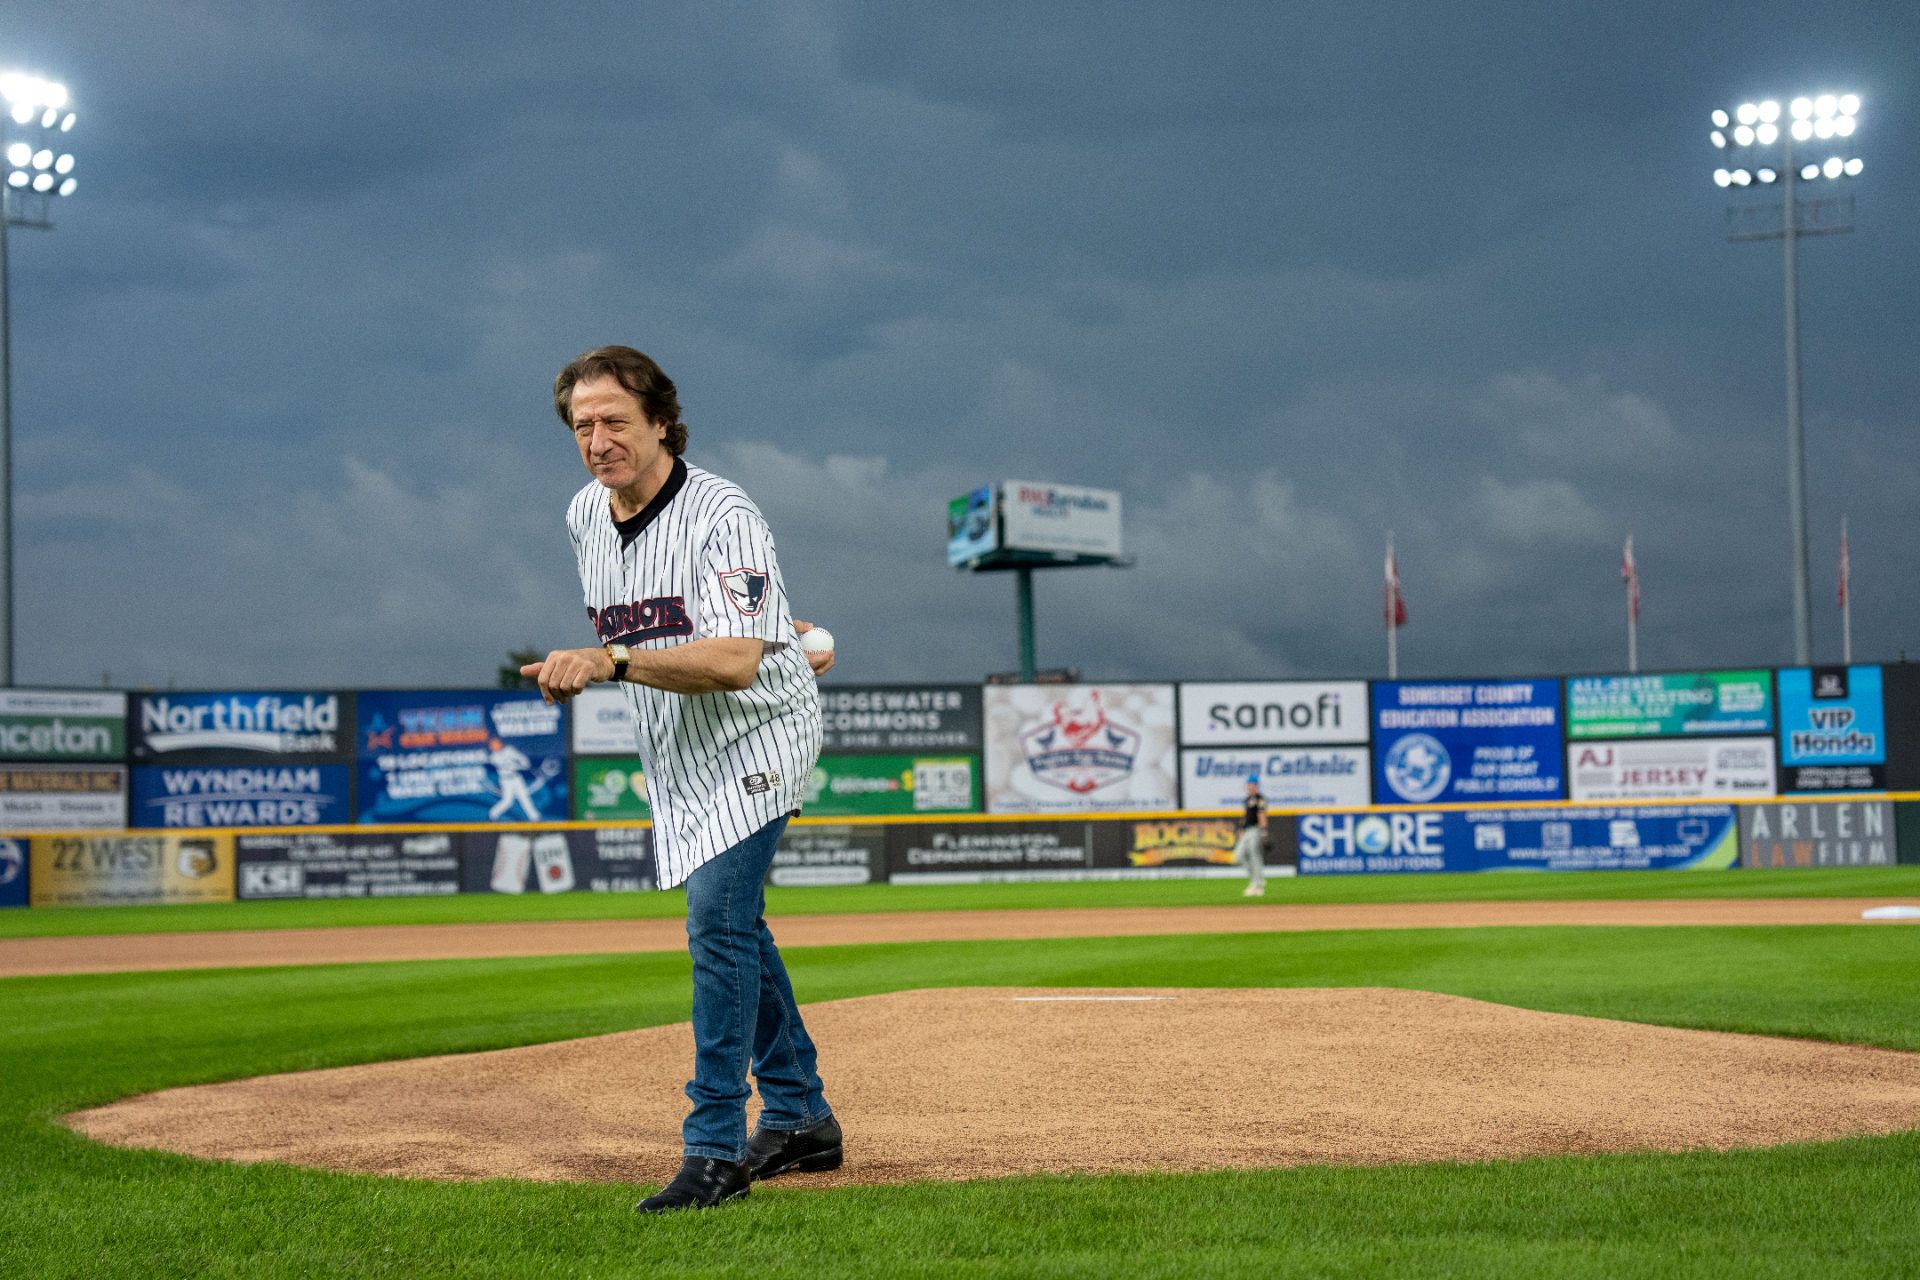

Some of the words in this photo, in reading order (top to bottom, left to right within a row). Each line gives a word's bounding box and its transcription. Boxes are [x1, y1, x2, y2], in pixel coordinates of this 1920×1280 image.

[1399, 685, 1472, 705] SOMERSET
[1475, 684, 1533, 704] COUNTY
[141, 696, 338, 732] Northfield
[1209, 693, 1341, 730] sanofi
[1380, 709, 1459, 729] EDUCATION
[1461, 707, 1555, 727] ASSOCIATION
[1809, 709, 1854, 730] VIP
[281, 733, 337, 752] Bank
[1792, 731, 1874, 754] Honda
[1196, 754, 1261, 777] Union
[1266, 753, 1358, 776] Catholic
[1579, 749, 1614, 767] AJ
[163, 768, 320, 794] WYNDHAM
[770, 773, 780, 783] 48
[1620, 767, 1706, 786] JERSEY
[164, 800, 320, 826] REWARDS
[1751, 804, 1884, 838] ARLEN
[932, 833, 1059, 851] FLEMINGTON
[1301, 813, 1445, 858] SHORE
[53, 838, 83, 870] 22
[90, 836, 165, 870] WEST
[907, 848, 1022, 865] DEPARTMENT
[1025, 847, 1085, 862] STORE
[1301, 858, 1364, 872] BUSINESS
[1367, 856, 1445, 870] SOLUTIONS
[1751, 841, 1813, 867] LAW
[1818, 841, 1886, 865] FIRM
